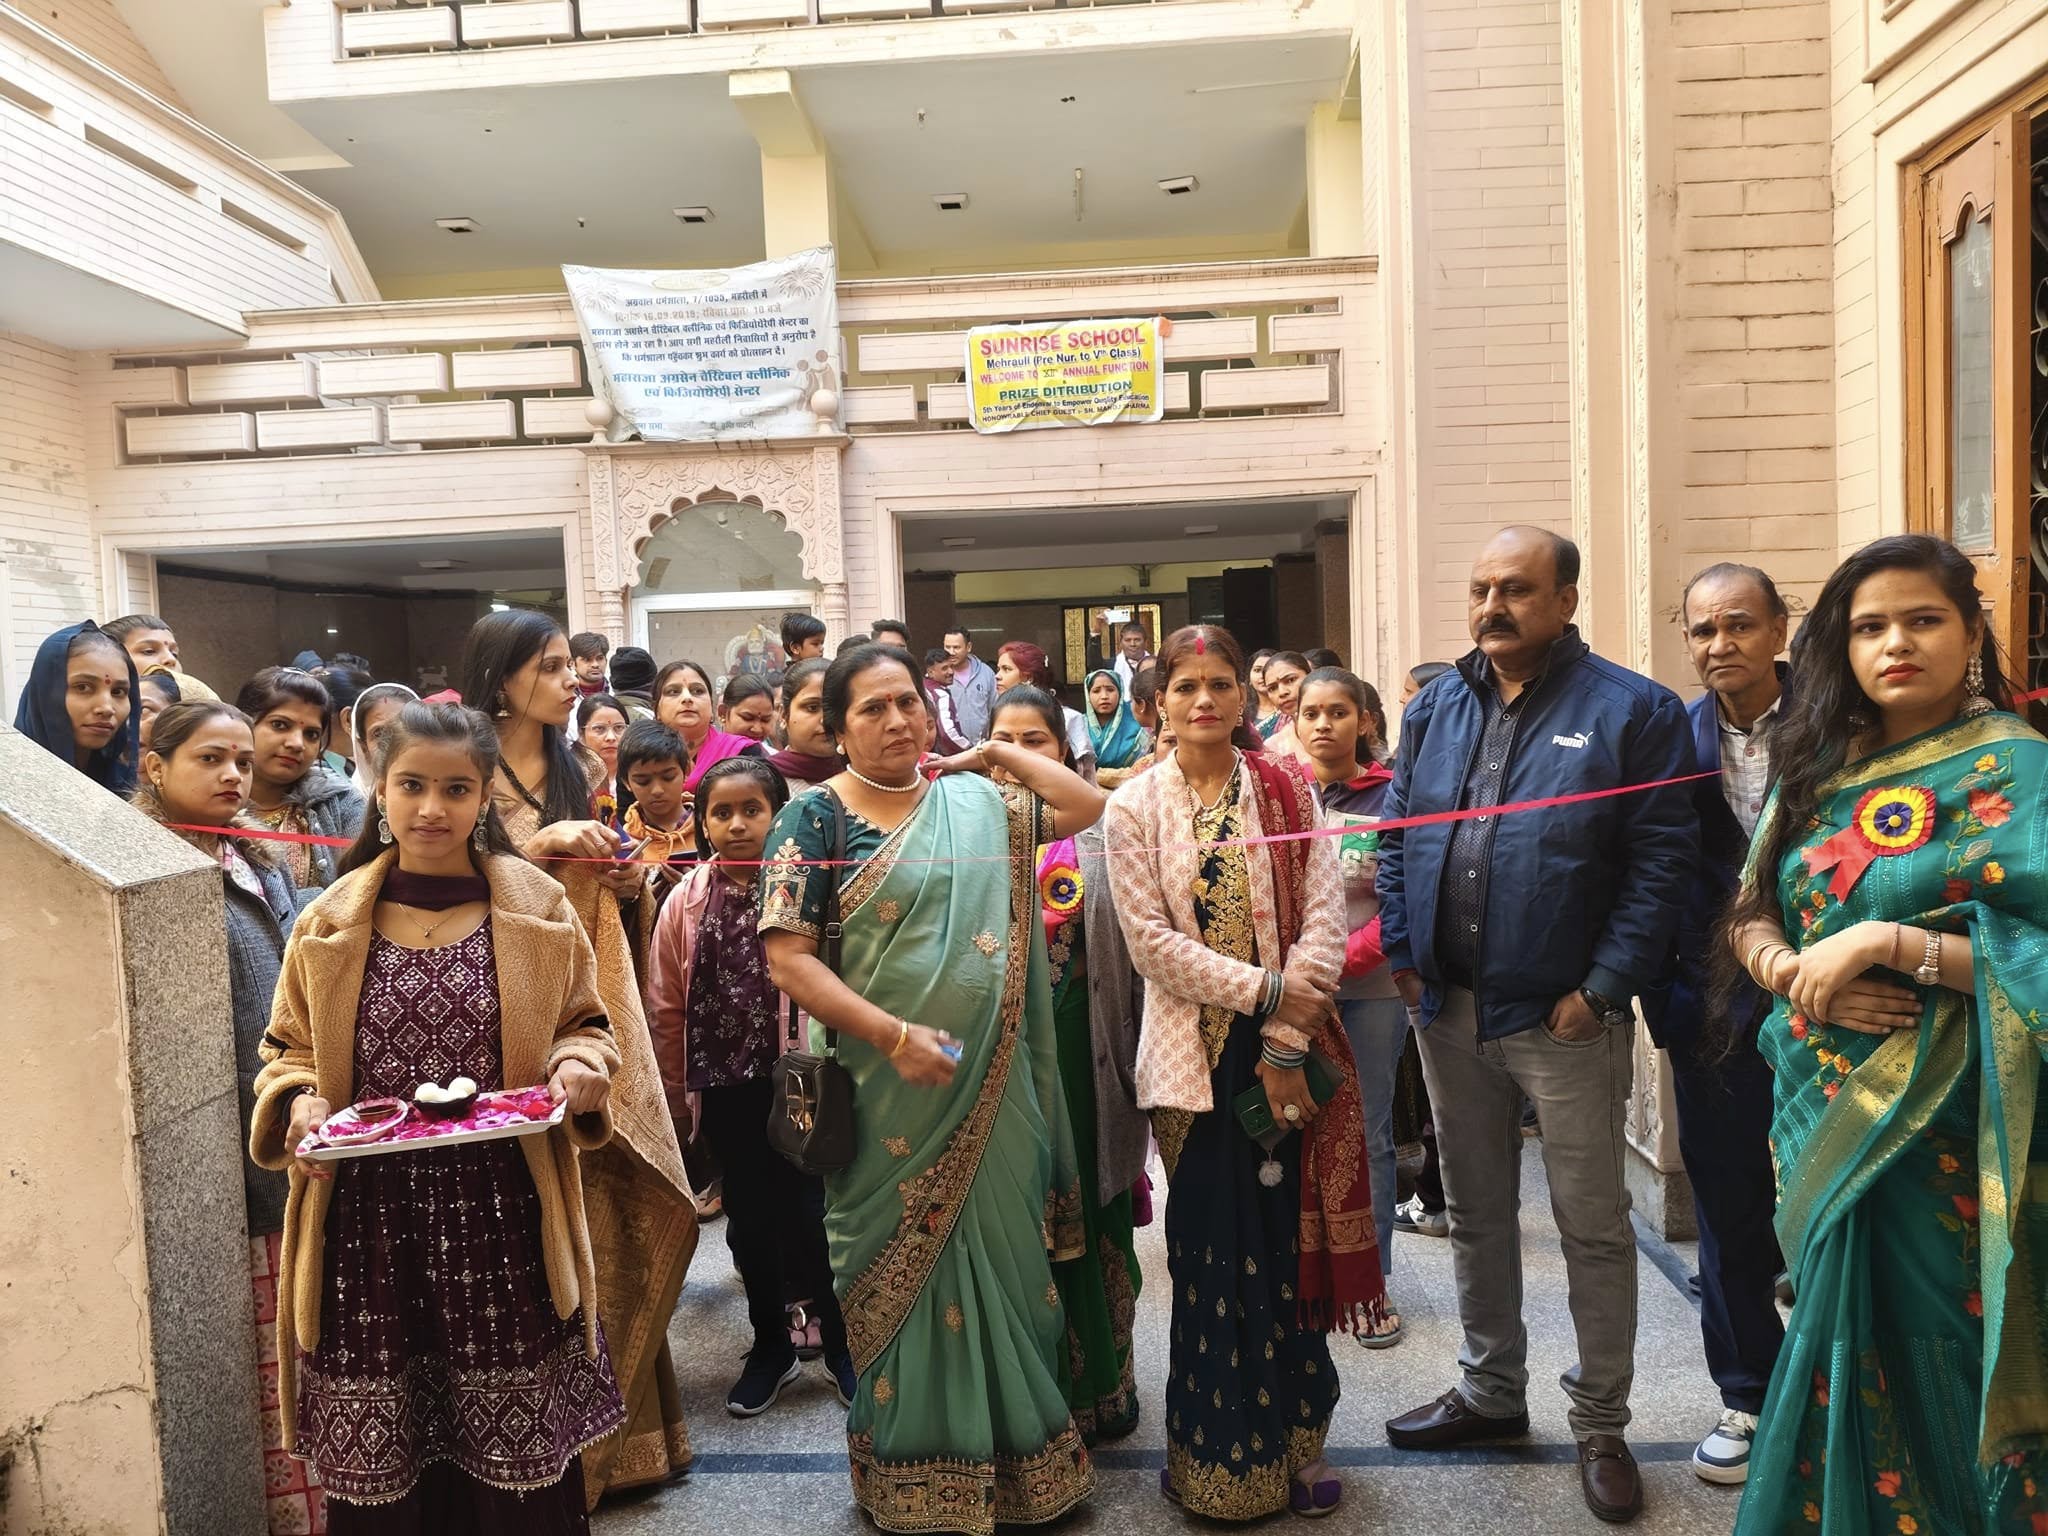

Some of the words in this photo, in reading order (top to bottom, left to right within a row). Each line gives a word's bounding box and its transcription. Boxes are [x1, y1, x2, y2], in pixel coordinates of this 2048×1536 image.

[981, 334, 1061, 356] SUNRISE
[1067, 327, 1145, 348] SCHOOL
[986, 355, 1030, 369] Mehrauli
[1033, 355, 1053, 367] (Pre
[1056, 353, 1076, 363] Nur.
[1080, 351, 1091, 361] to
[1110, 346, 1141, 358] Class)
[980, 370, 1024, 384] WELCOME
[1027, 369, 1038, 379] TO
[1063, 365, 1101, 376] ANNUAL
[1103, 361, 1149, 373] FUNCTION
[999, 388, 1038, 400] PRIZE
[1043, 380, 1132, 397] DITRIBUTION
[1552, 735, 1584, 748] PUMA
